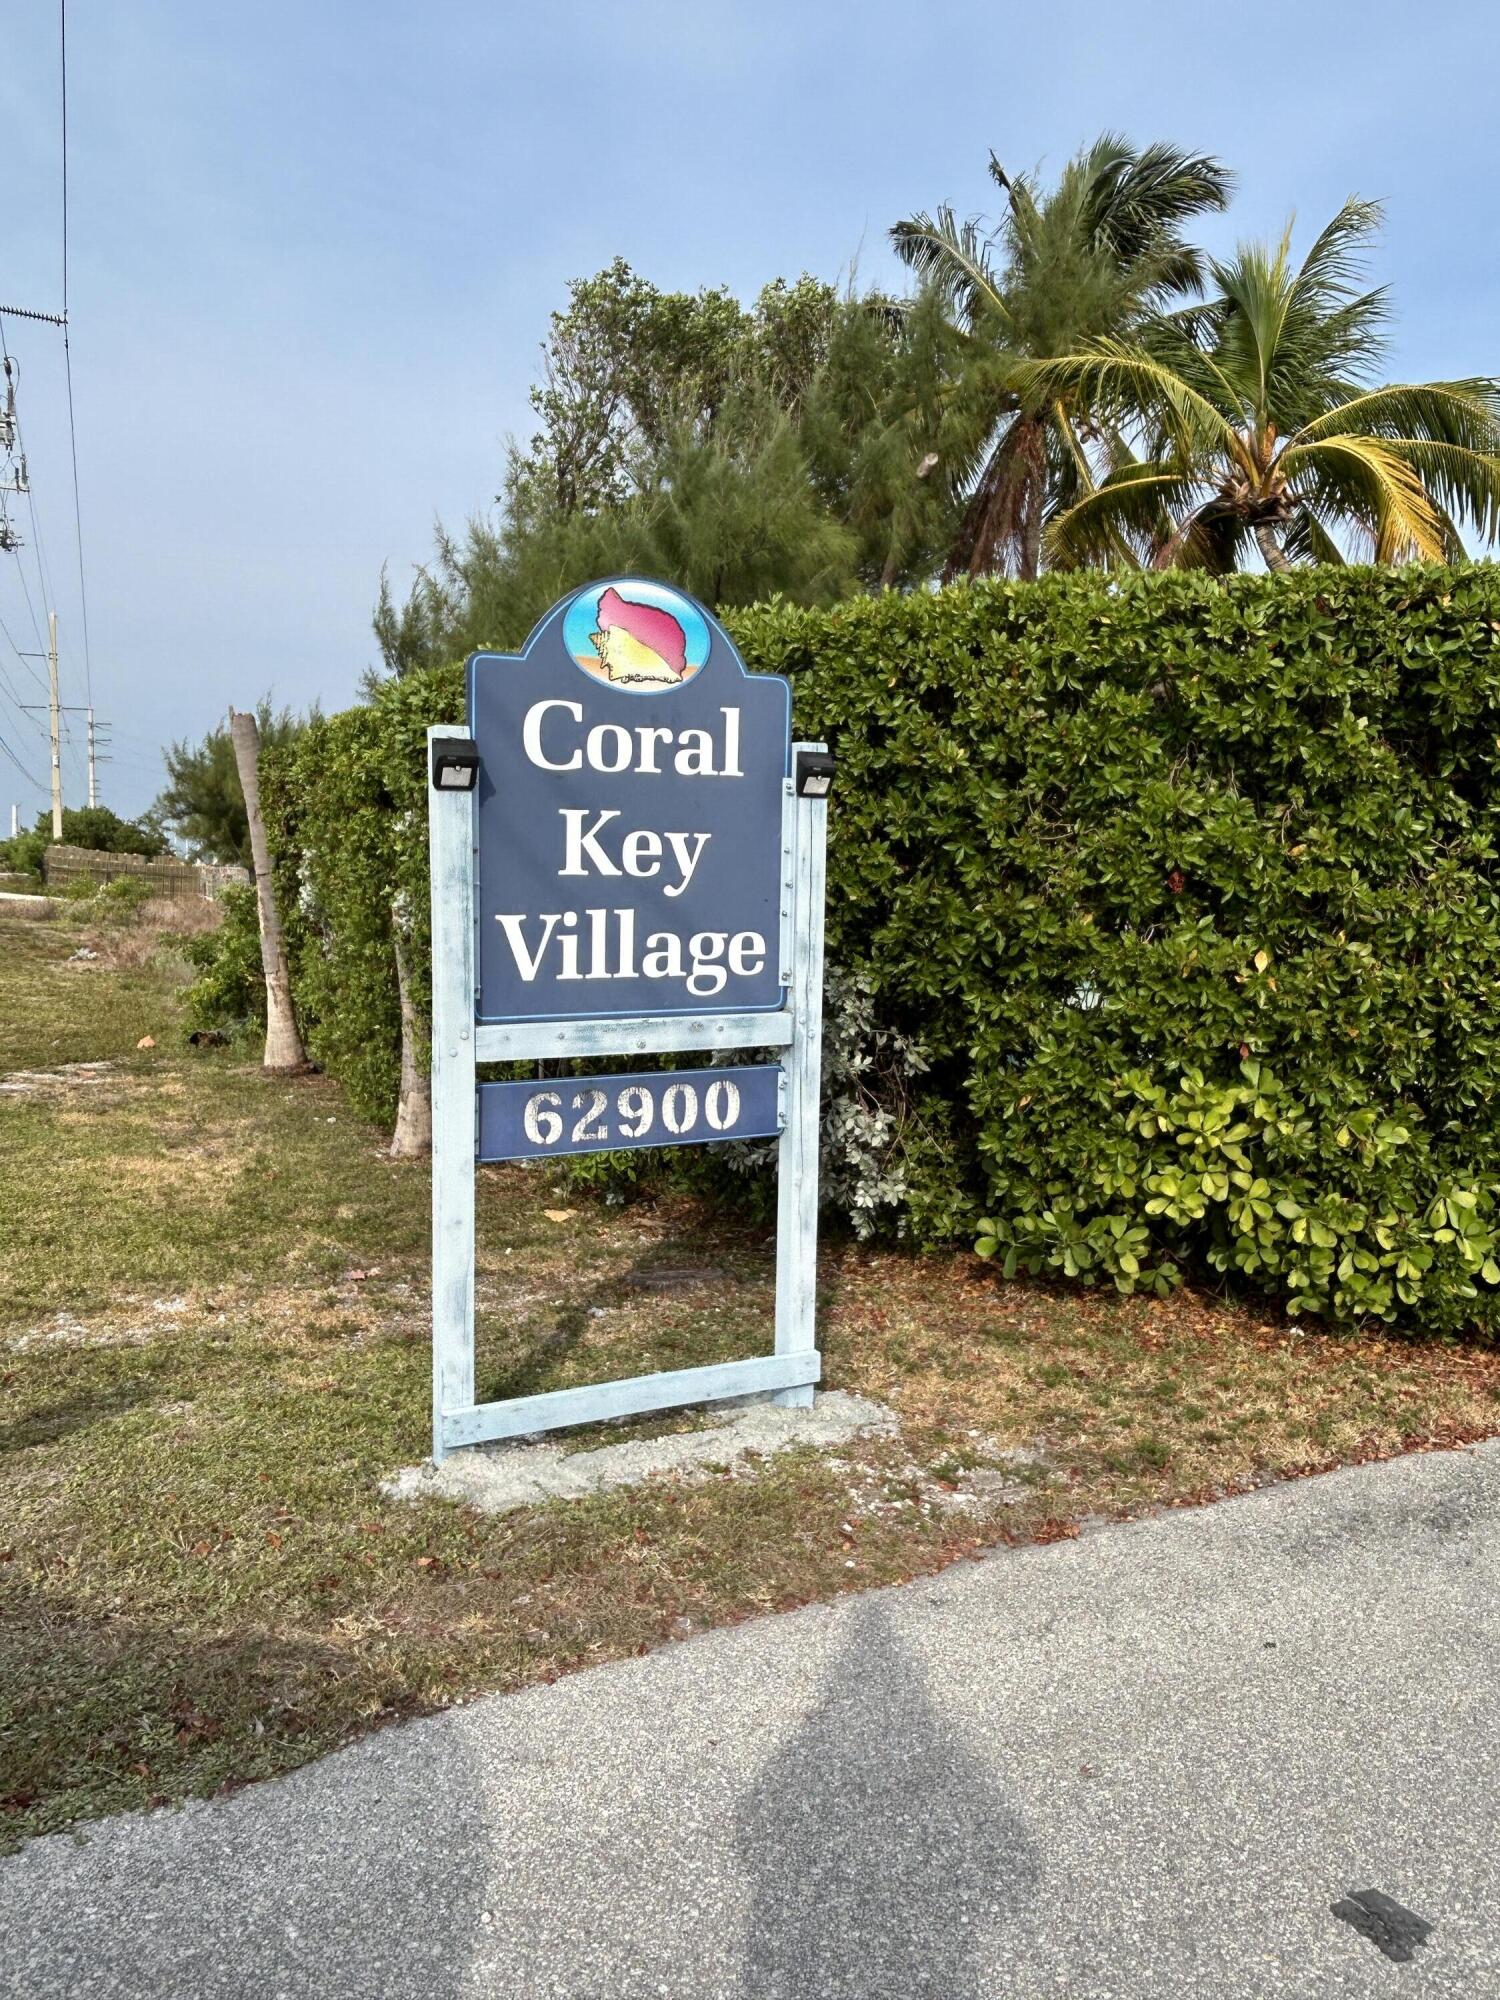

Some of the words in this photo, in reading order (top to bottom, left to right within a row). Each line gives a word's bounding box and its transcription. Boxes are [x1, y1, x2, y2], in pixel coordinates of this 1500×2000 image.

[523, 699, 745, 777] Coral
[557, 808, 712, 897] Key
[494, 908, 767, 997] Village
[523, 1080, 741, 1145] 62900
